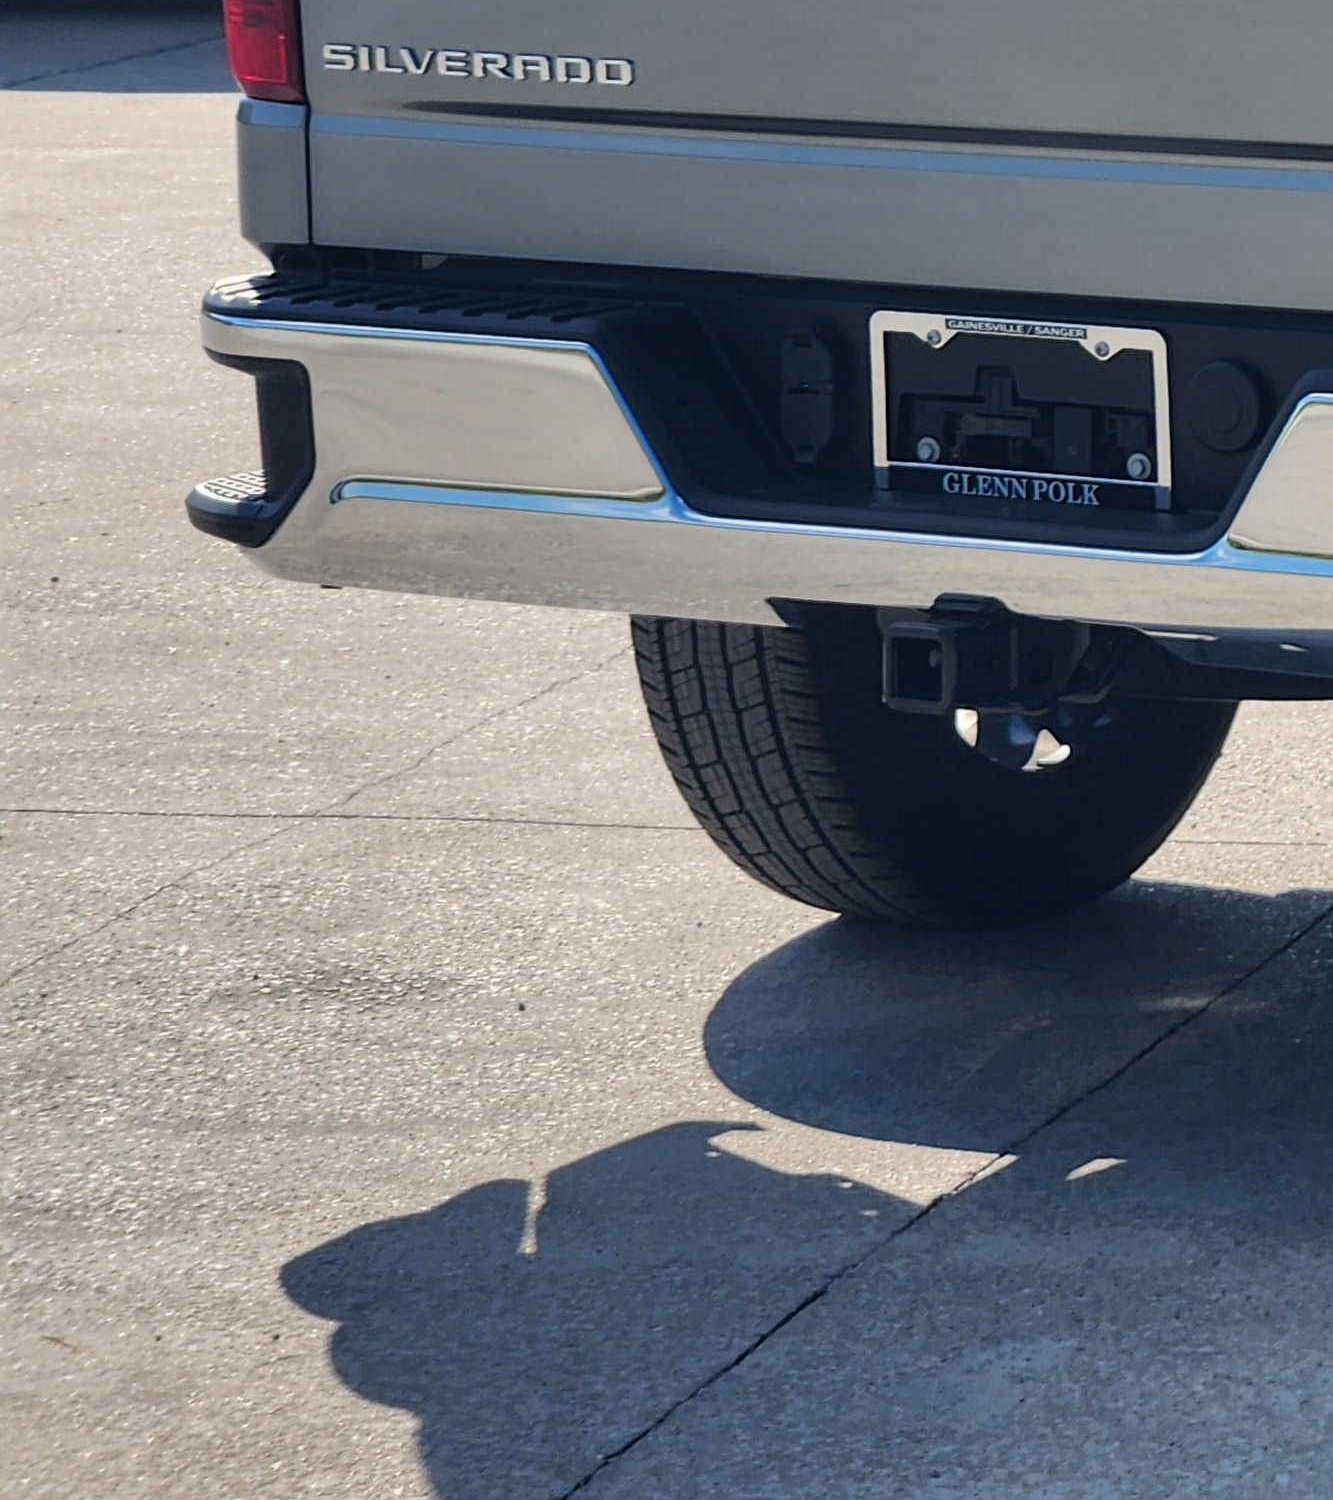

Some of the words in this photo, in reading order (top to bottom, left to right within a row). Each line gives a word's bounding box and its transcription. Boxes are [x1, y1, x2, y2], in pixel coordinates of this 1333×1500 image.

[322, 43, 635, 86] SILVERADO
[947, 319, 1025, 334] GAINESVILLE
[1034, 325, 1086, 338] SANGER
[942, 471, 1028, 499] GLENN
[1032, 479, 1100, 506] POLK
